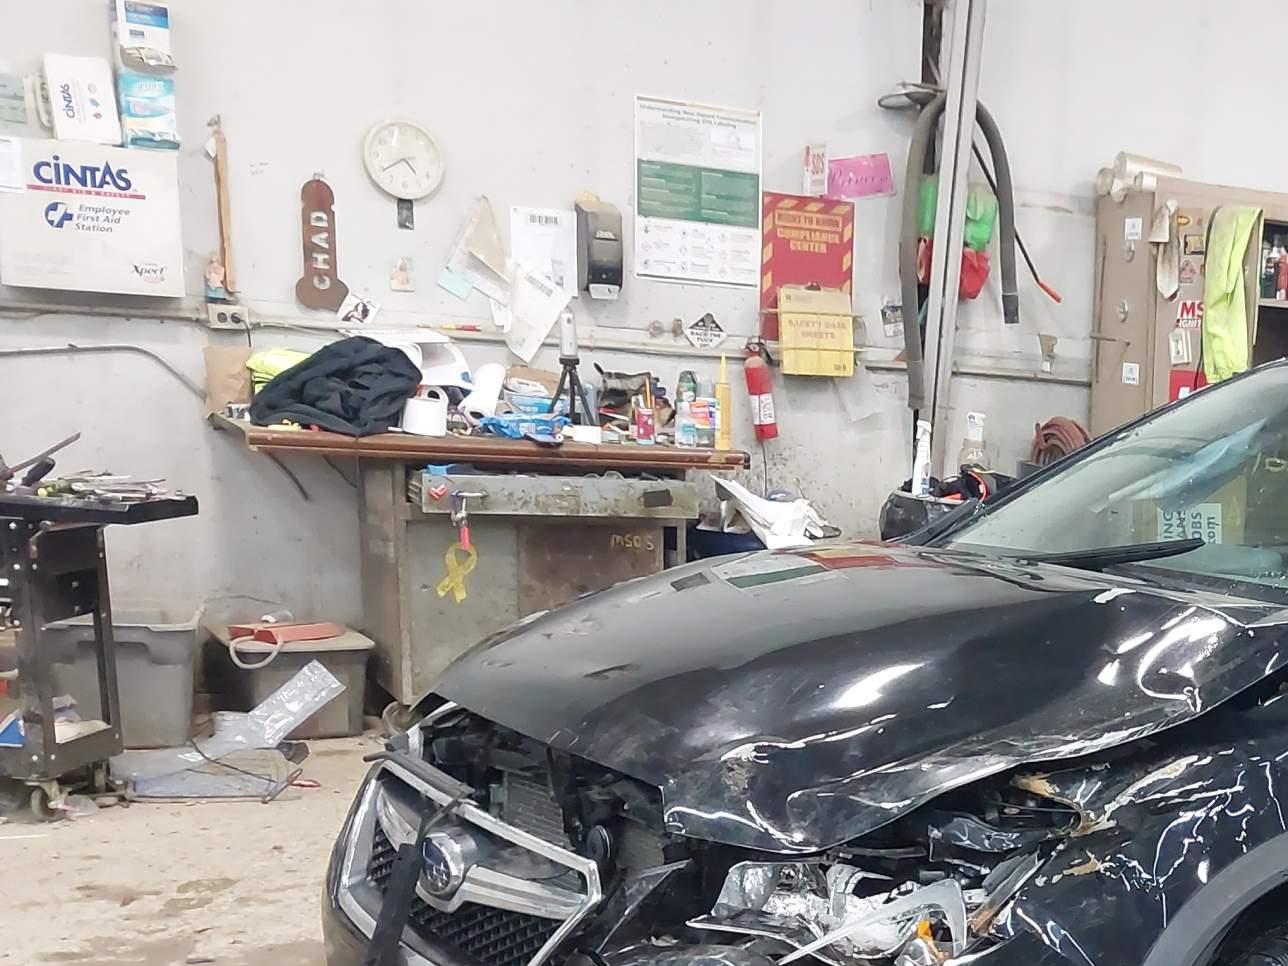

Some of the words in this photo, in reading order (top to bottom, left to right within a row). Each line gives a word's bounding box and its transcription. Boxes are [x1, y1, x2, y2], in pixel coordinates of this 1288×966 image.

[33, 154, 132, 192] CINTAS
[79, 203, 130, 216] Employee
[77, 213, 100, 223] First
[103, 215, 121, 225] Aid
[803, 215, 815, 225] TO
[75, 222, 113, 234] Station
[777, 227, 841, 244] COMPLIANCE
[310, 211, 331, 290] CHAD
[789, 240, 827, 254] CENTER
[132, 264, 165, 277] Xpect
[787, 319, 821, 330] SAFETY
